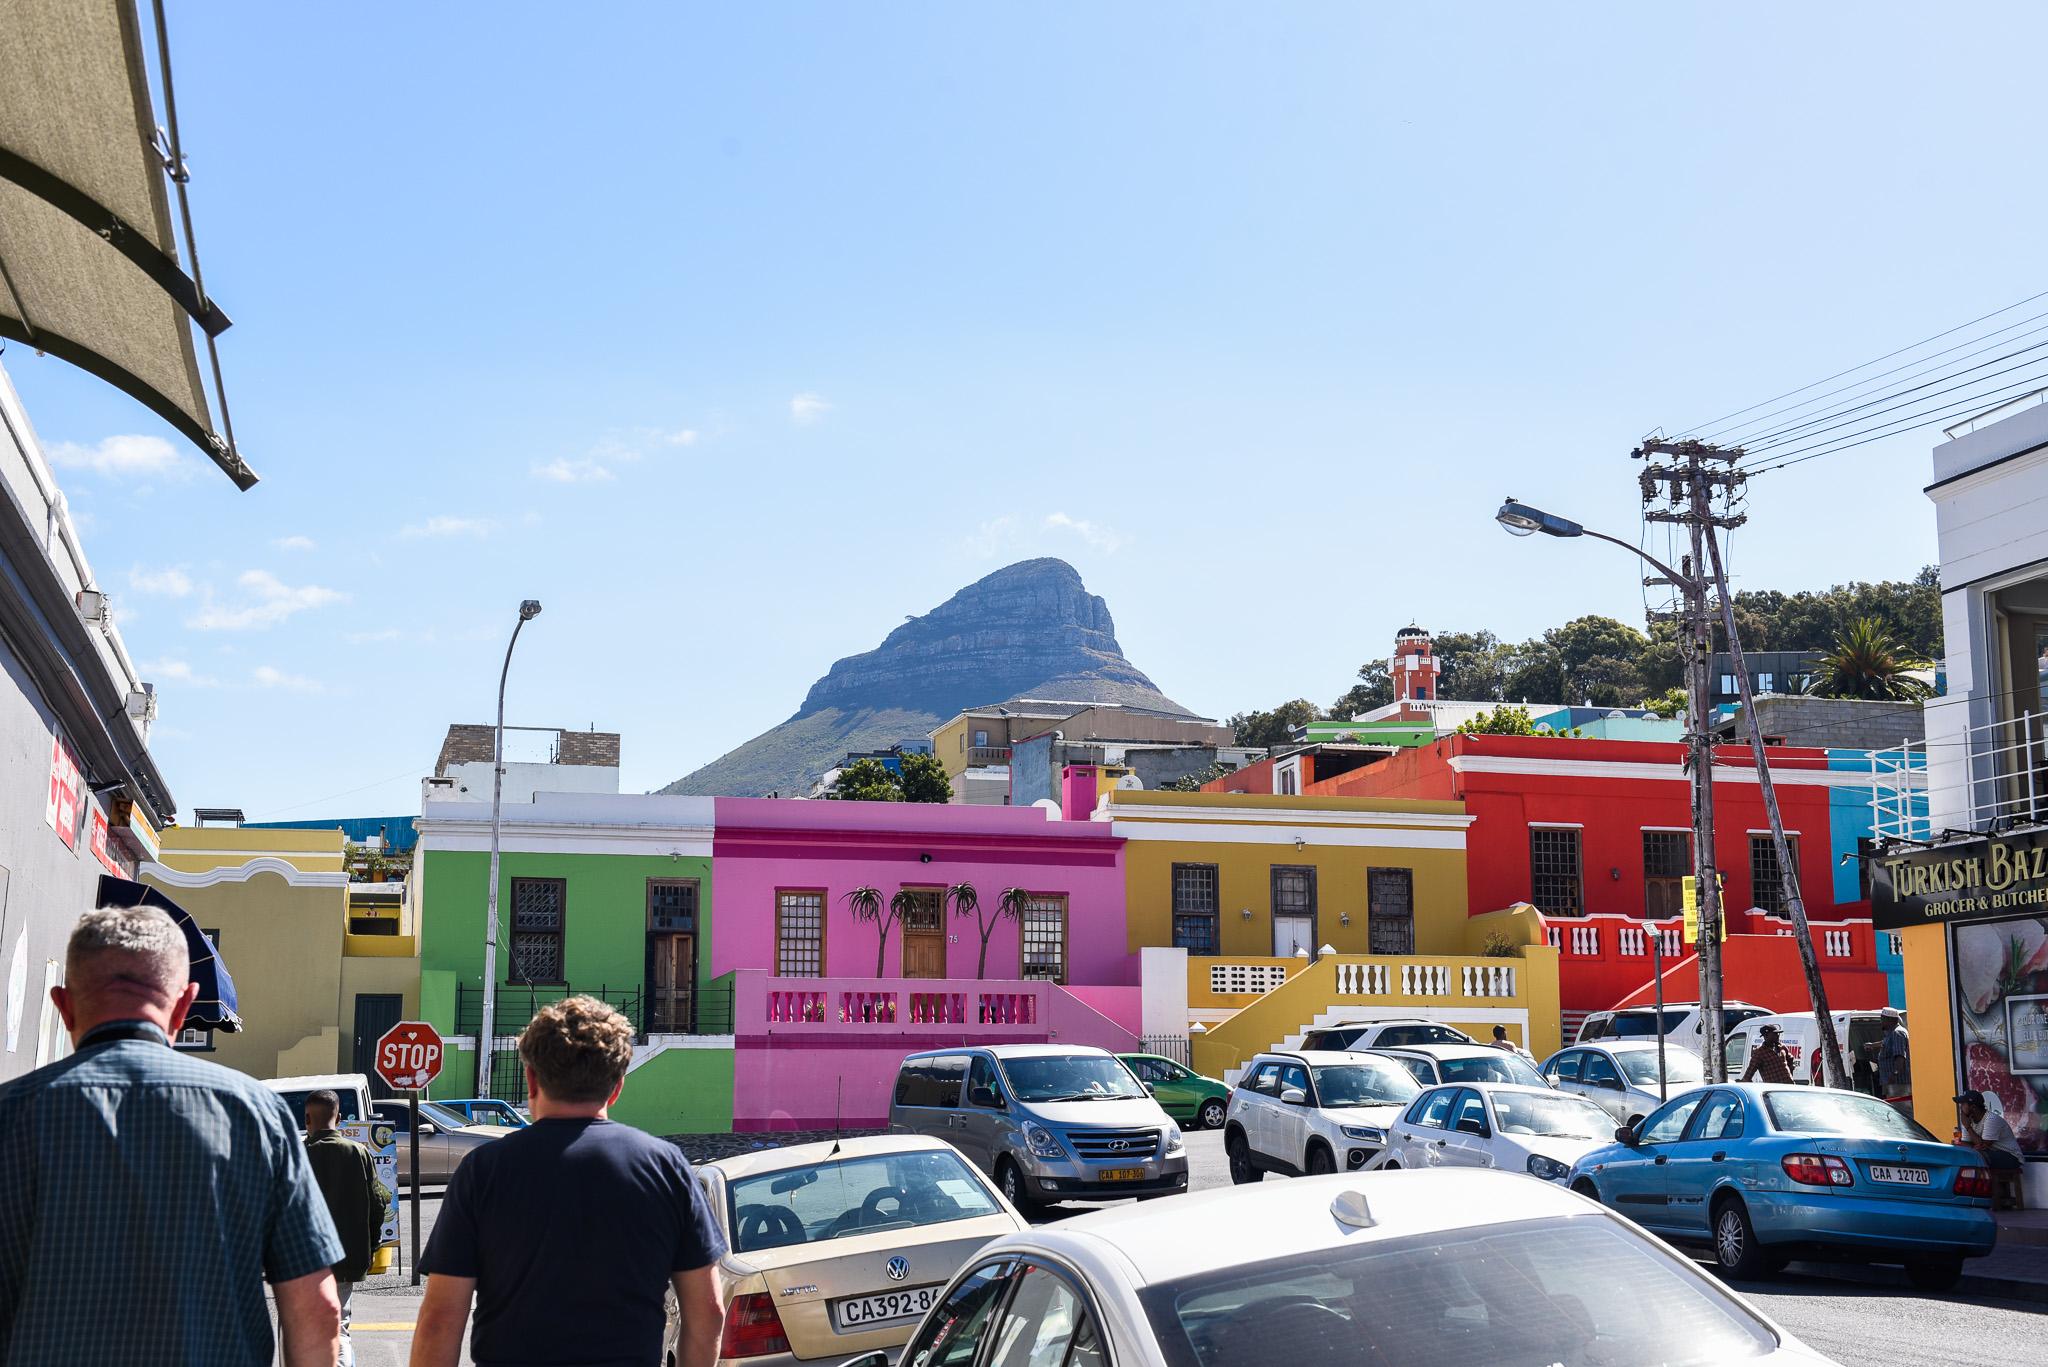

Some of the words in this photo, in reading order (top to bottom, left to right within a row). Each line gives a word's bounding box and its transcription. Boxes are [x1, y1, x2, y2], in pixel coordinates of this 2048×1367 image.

[1885, 857, 1980, 903] TURKISH
[1924, 897, 1976, 917] GROCER
[1979, 896, 1989, 910] &
[949, 935, 958, 944] 75
[383, 1043, 439, 1069] STOP
[1872, 1167, 1892, 1180] CAA
[1898, 1168, 1928, 1183] 12720
